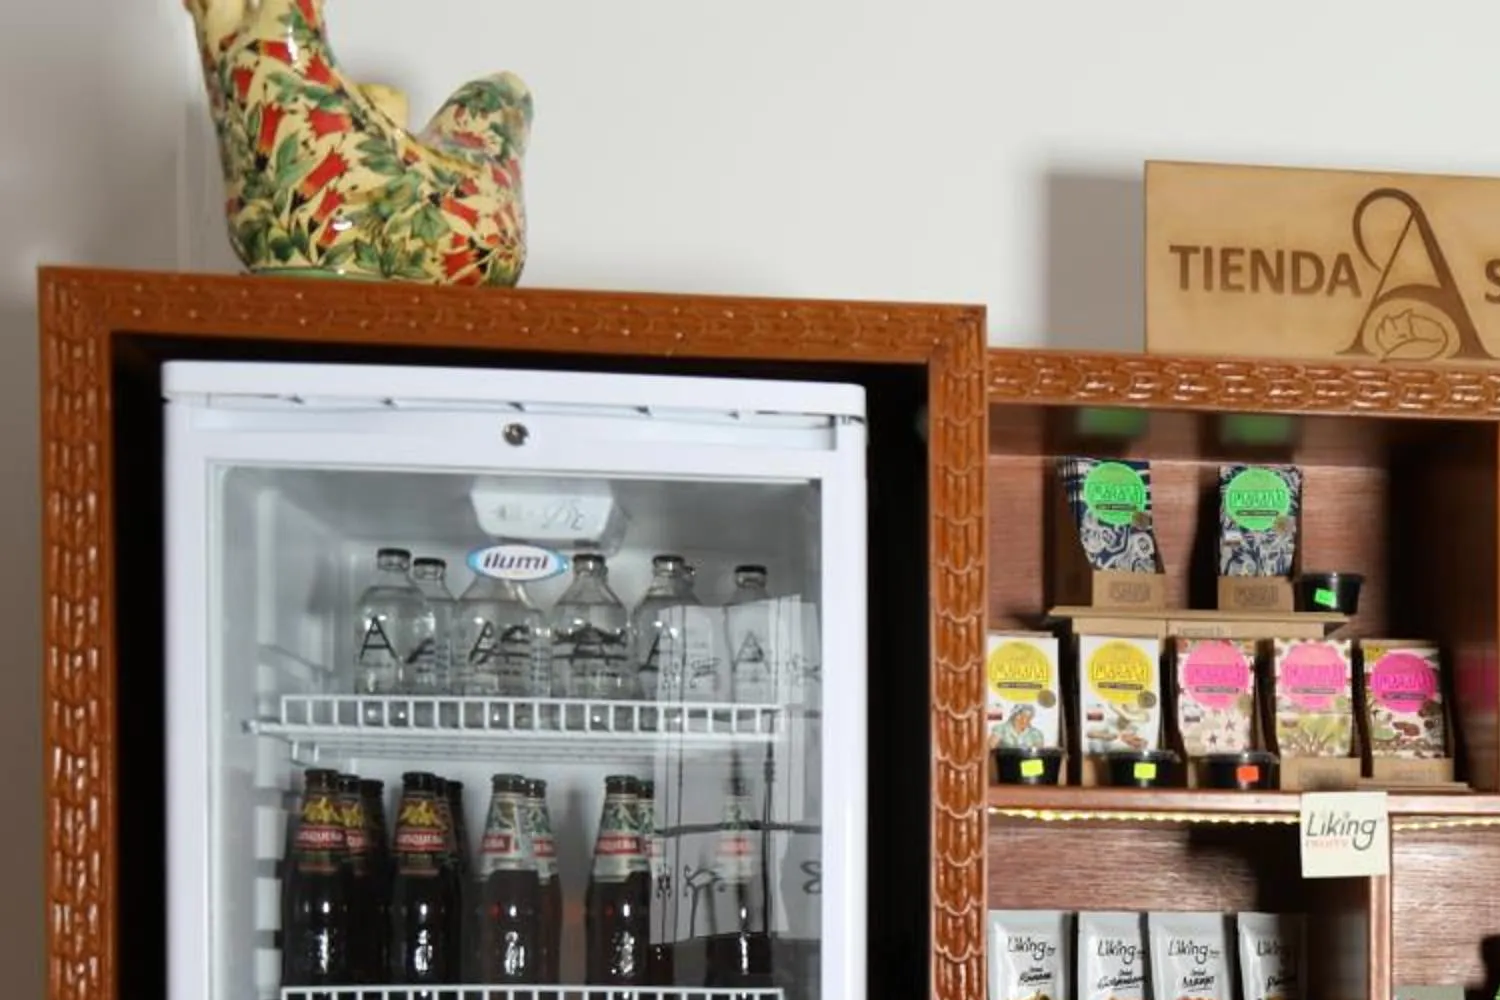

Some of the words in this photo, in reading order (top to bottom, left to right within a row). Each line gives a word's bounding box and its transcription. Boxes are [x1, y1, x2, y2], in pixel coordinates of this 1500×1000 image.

[1169, 244, 1362, 298] TIENDA
[483, 552, 549, 570] ilumi
[359, 615, 400, 660] A
[1305, 811, 1377, 851] Liking
[1007, 936, 1047, 961] Liking
[1097, 939, 1137, 965] Liking
[1167, 939, 1209, 965] Liking
